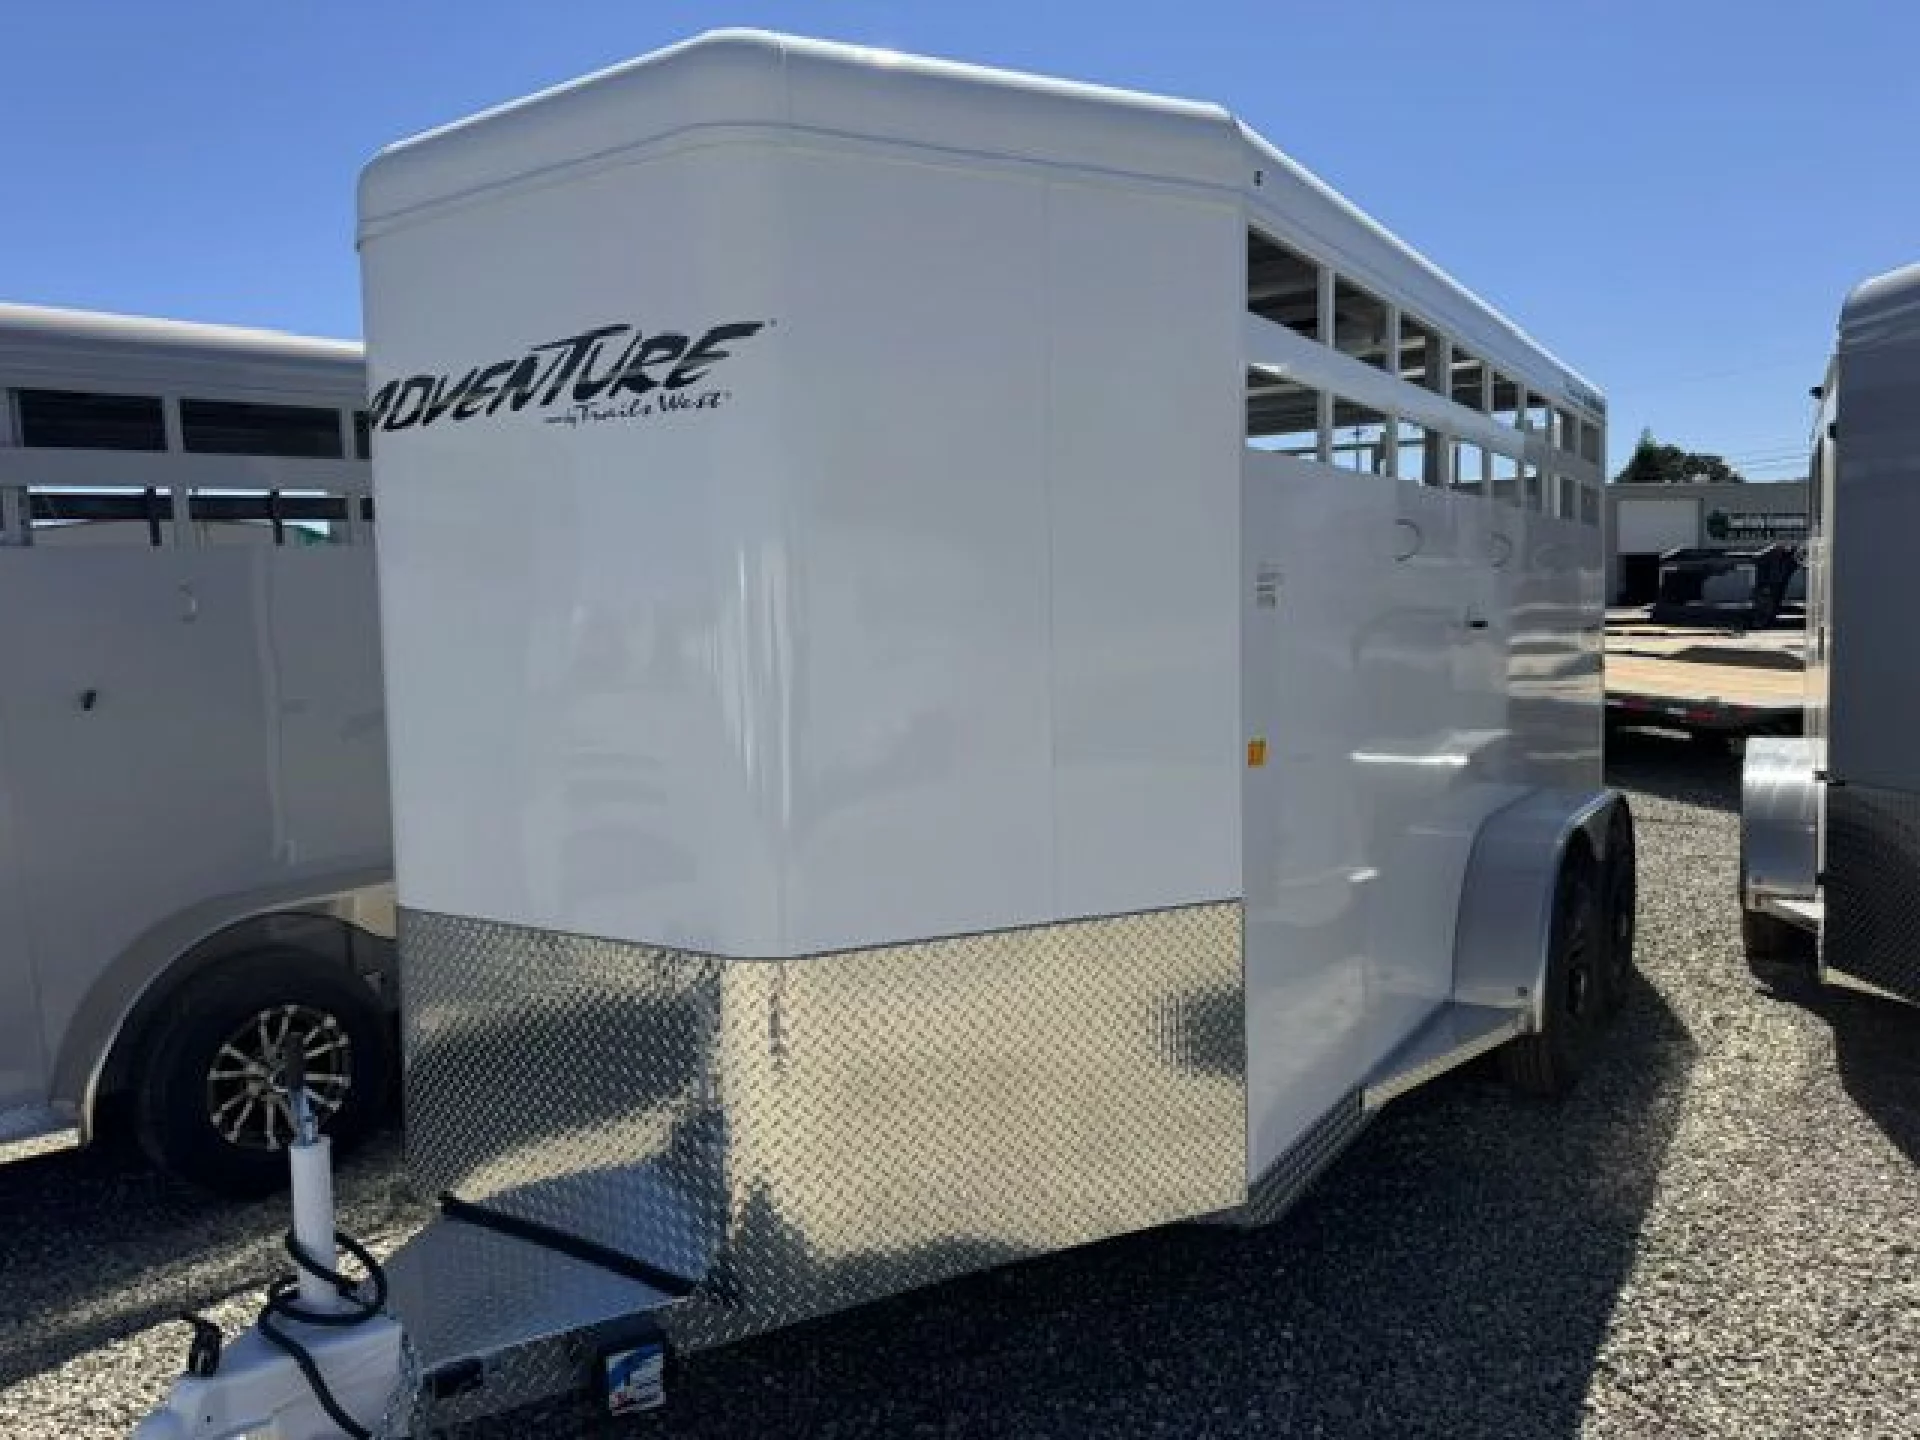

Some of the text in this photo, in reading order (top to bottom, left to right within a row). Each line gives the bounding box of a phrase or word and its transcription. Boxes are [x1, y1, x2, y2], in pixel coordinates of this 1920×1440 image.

[369, 322, 765, 432] ADVENTURE
[573, 398, 651, 421] Trails
[657, 392, 721, 412] West
